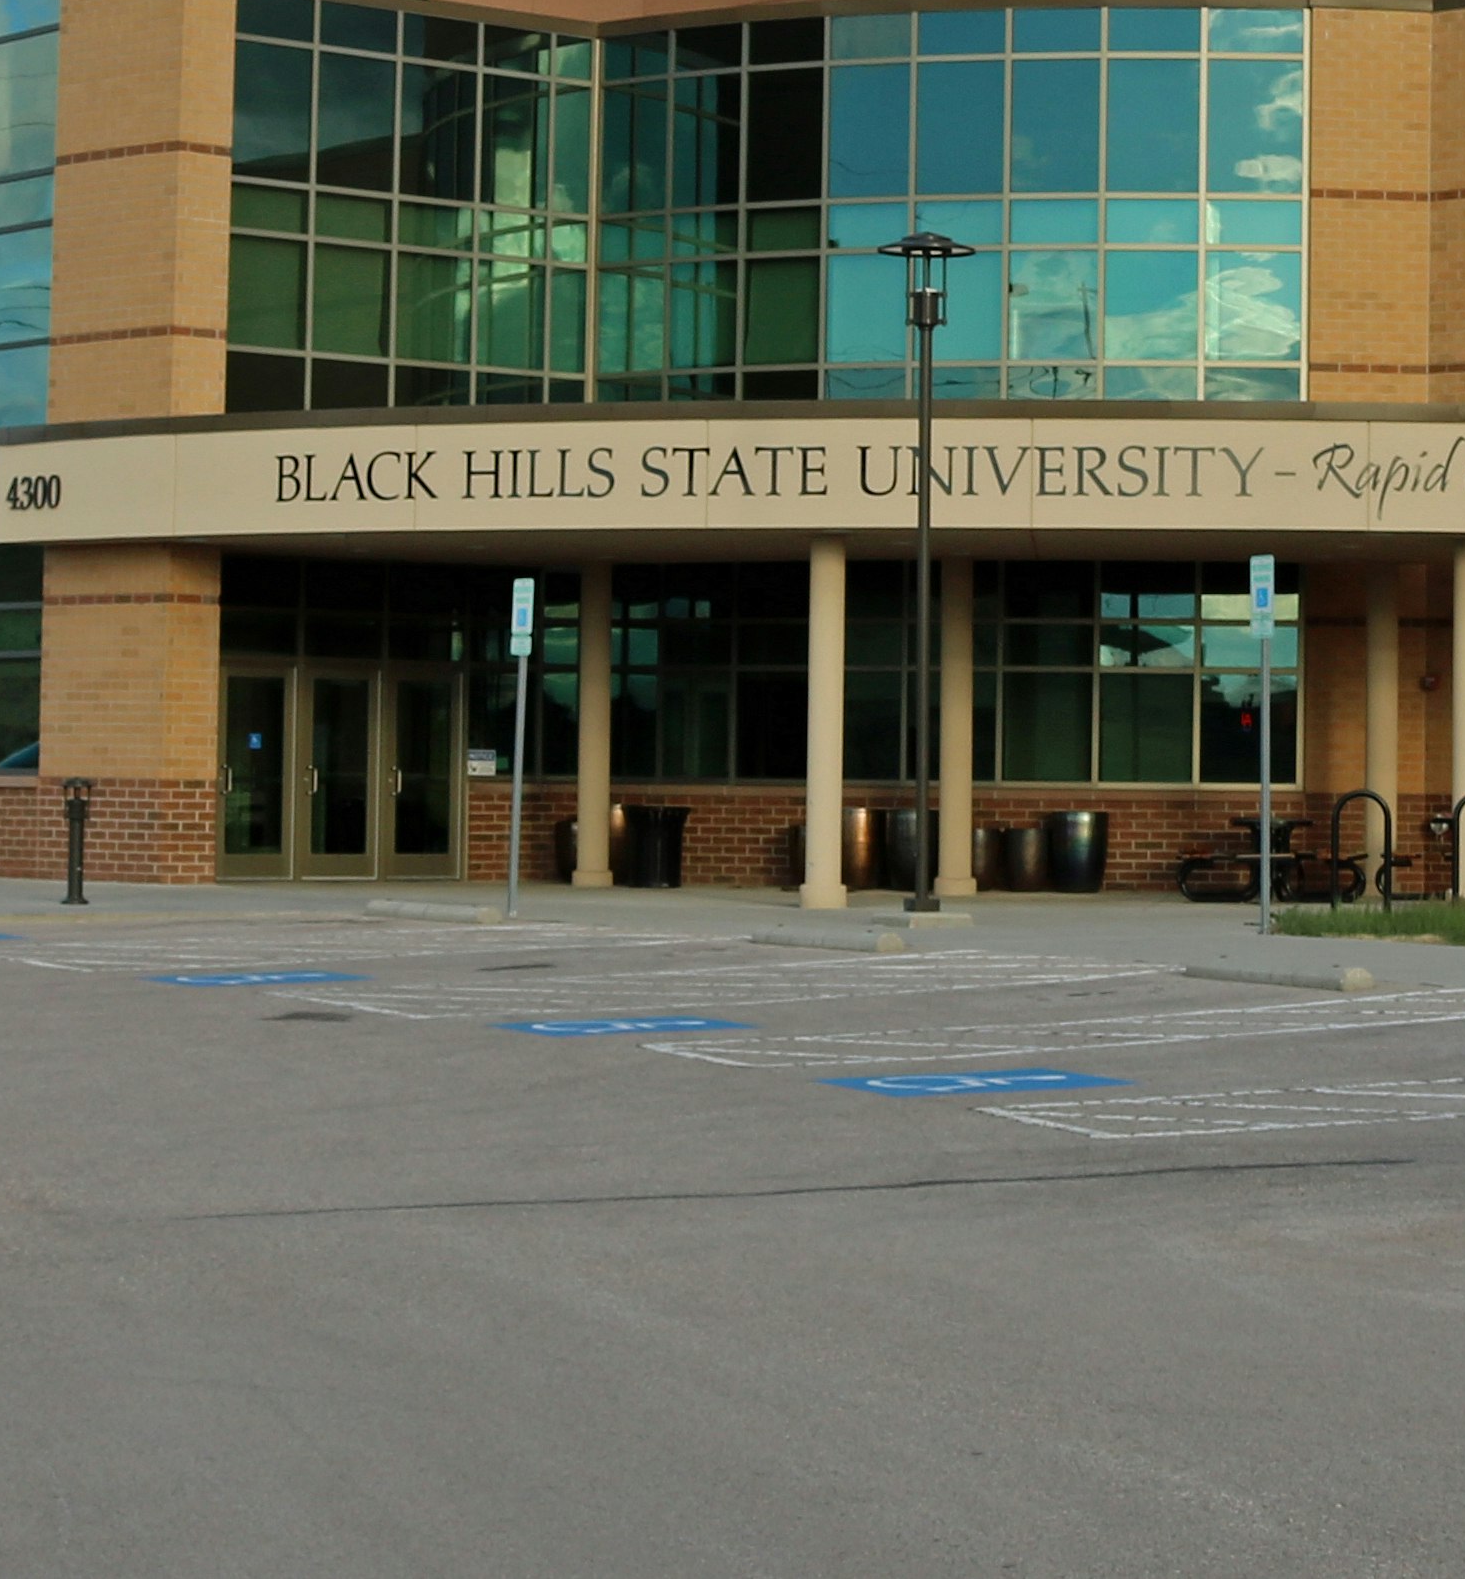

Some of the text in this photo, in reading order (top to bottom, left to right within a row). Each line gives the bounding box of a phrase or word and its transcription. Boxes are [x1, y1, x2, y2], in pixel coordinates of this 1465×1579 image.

[6, 474, 61, 511] 4300
[275, 451, 438, 502] BLACK
[462, 447, 615, 499] HILLS
[641, 446, 828, 497] STATE
[856, 445, 1264, 498] UNIVERSITY
[1312, 436, 1465, 521] Rapid
